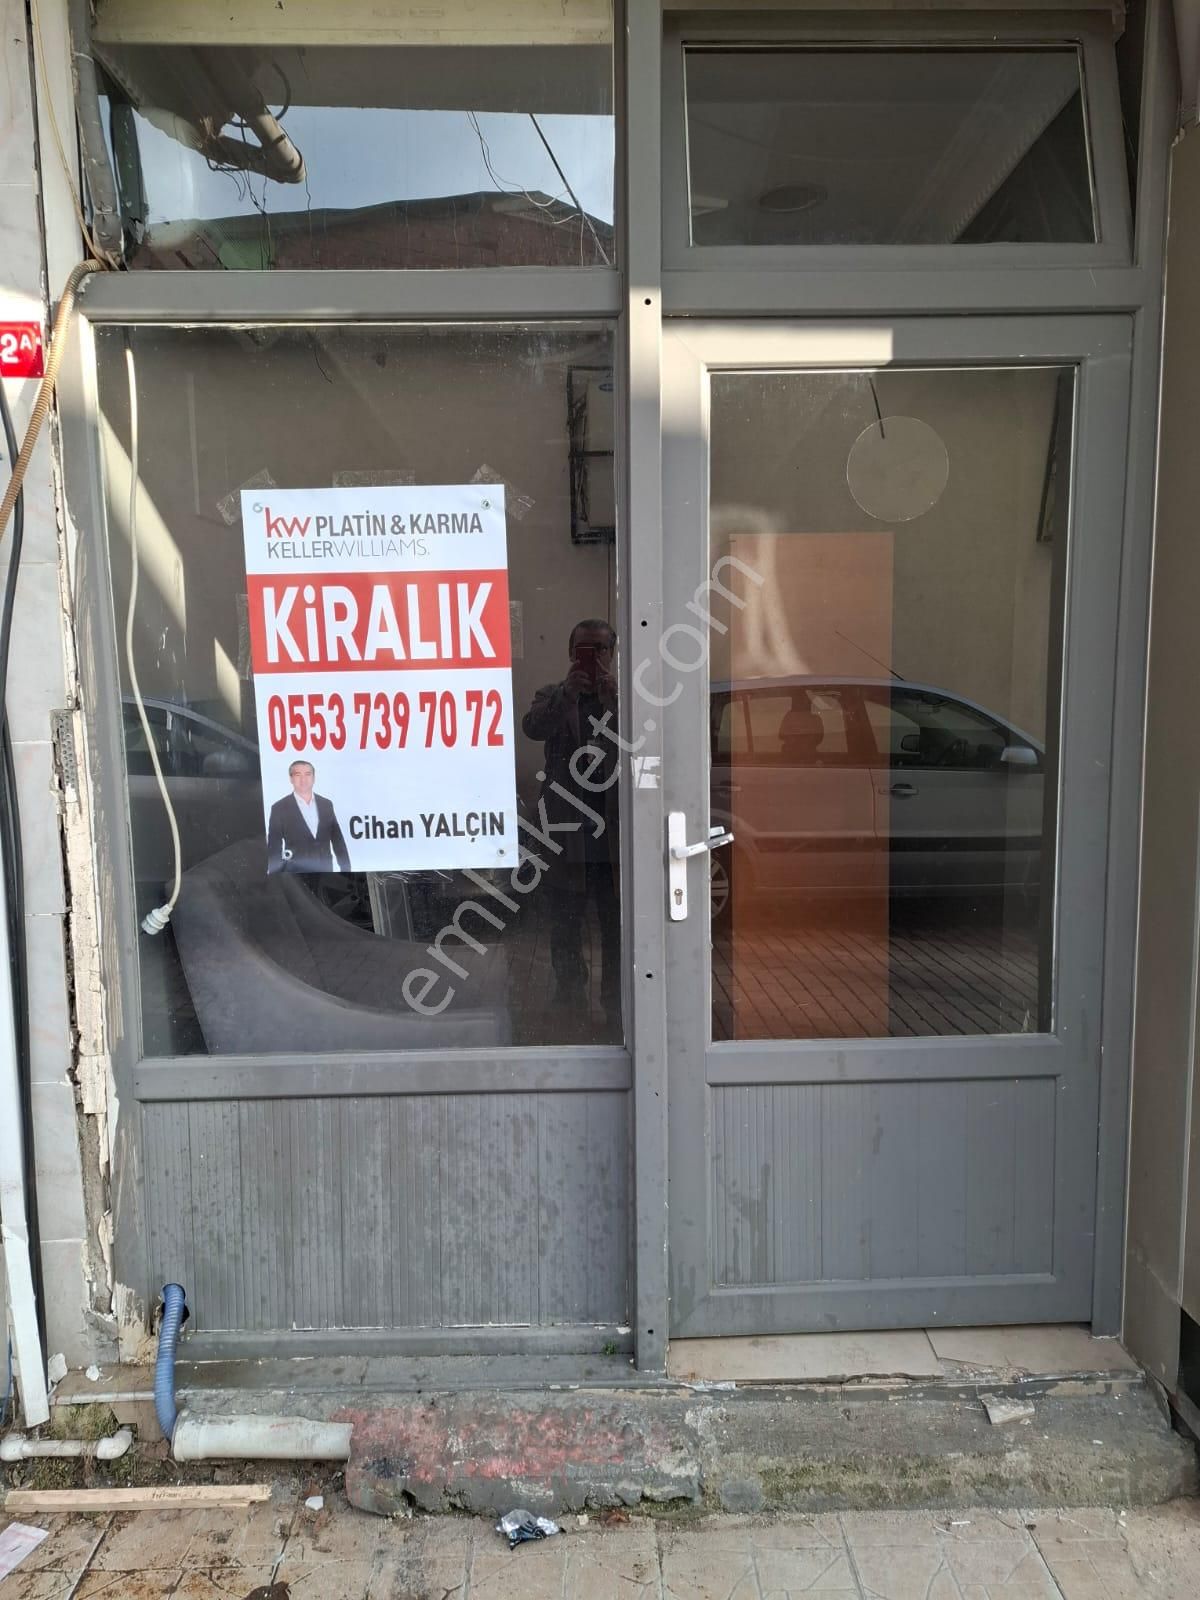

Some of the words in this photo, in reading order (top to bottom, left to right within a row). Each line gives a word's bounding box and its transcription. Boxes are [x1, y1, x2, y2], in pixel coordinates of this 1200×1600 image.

[264, 507, 312, 538] kw
[315, 510, 387, 537] PLATİN
[390, 514, 406, 536] &
[409, 512, 484, 535] KARMA
[267, 693, 347, 752] 0553
[354, 690, 411, 750] 739
[419, 689, 458, 749] 70
[465, 688, 505, 748] 72
[349, 814, 414, 841] Cihan
